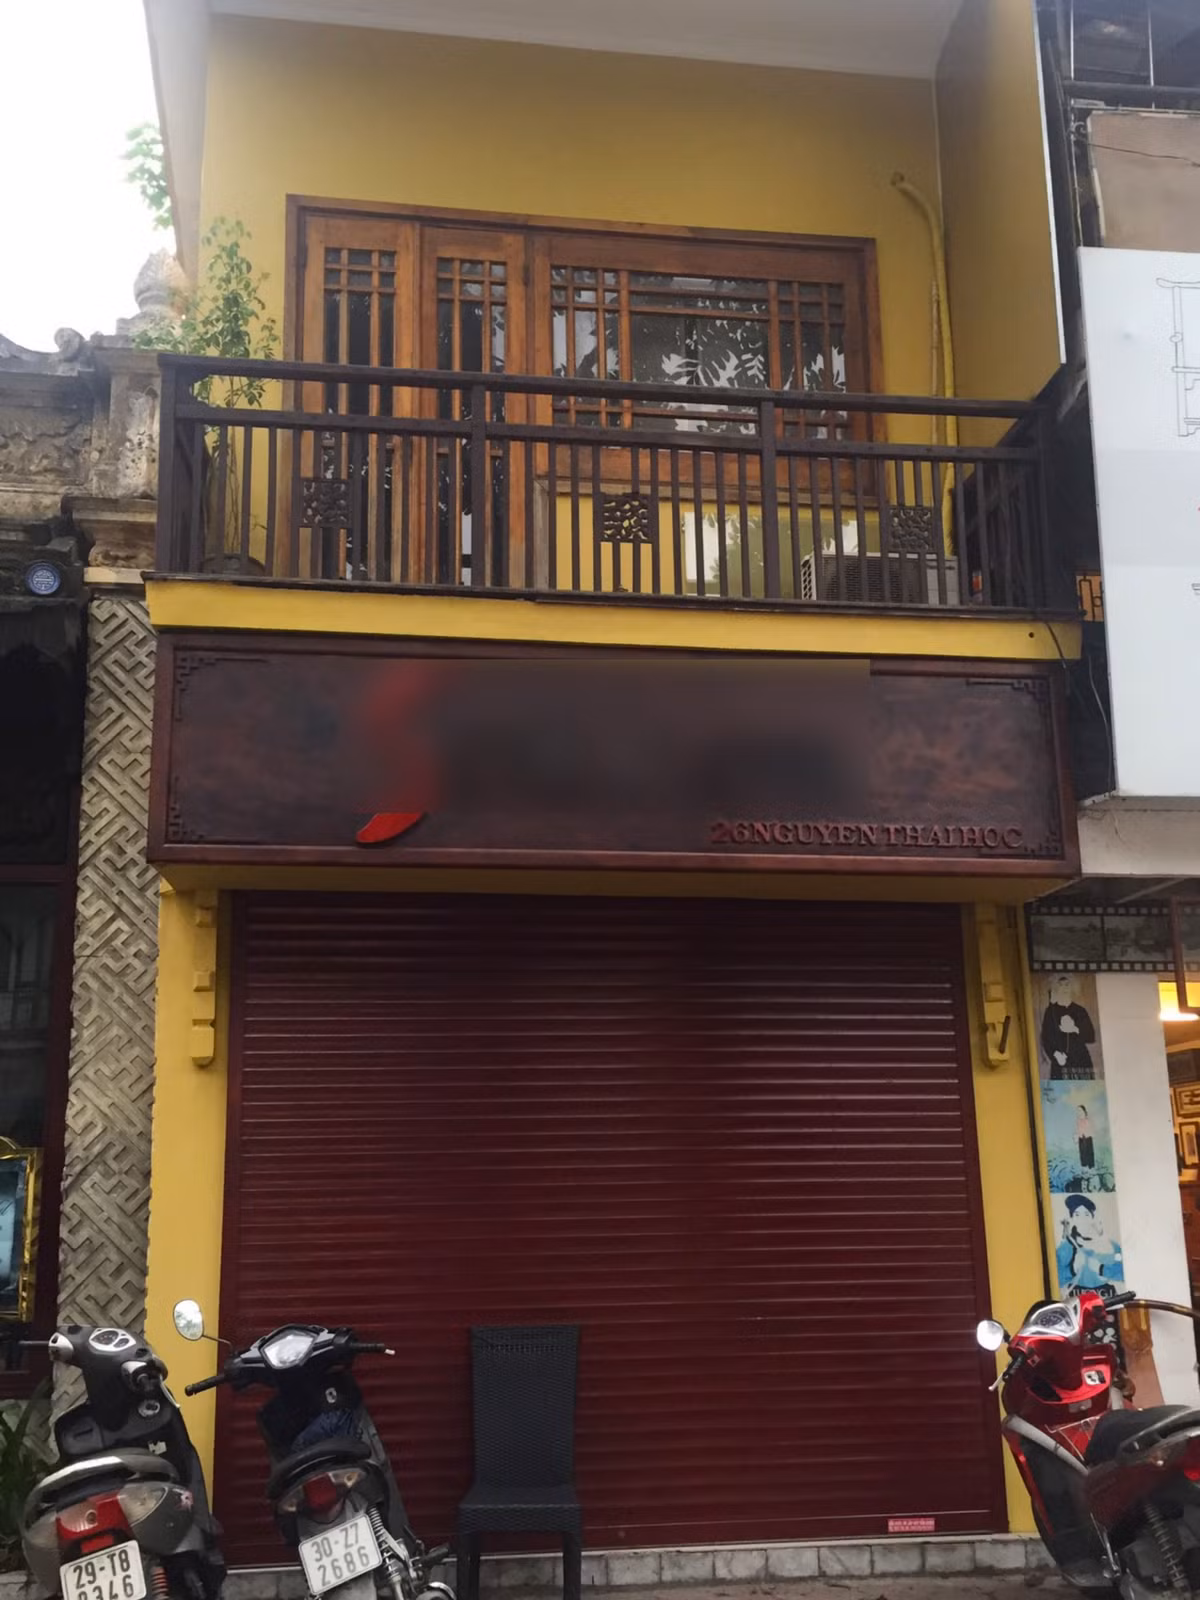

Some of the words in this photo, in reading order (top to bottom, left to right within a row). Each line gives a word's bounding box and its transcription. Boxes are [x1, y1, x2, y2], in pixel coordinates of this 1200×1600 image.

[959, 825, 1024, 849] HOC
[73, 1549, 131, 1590] 29-T8
[317, 1545, 370, 1587] 2686
